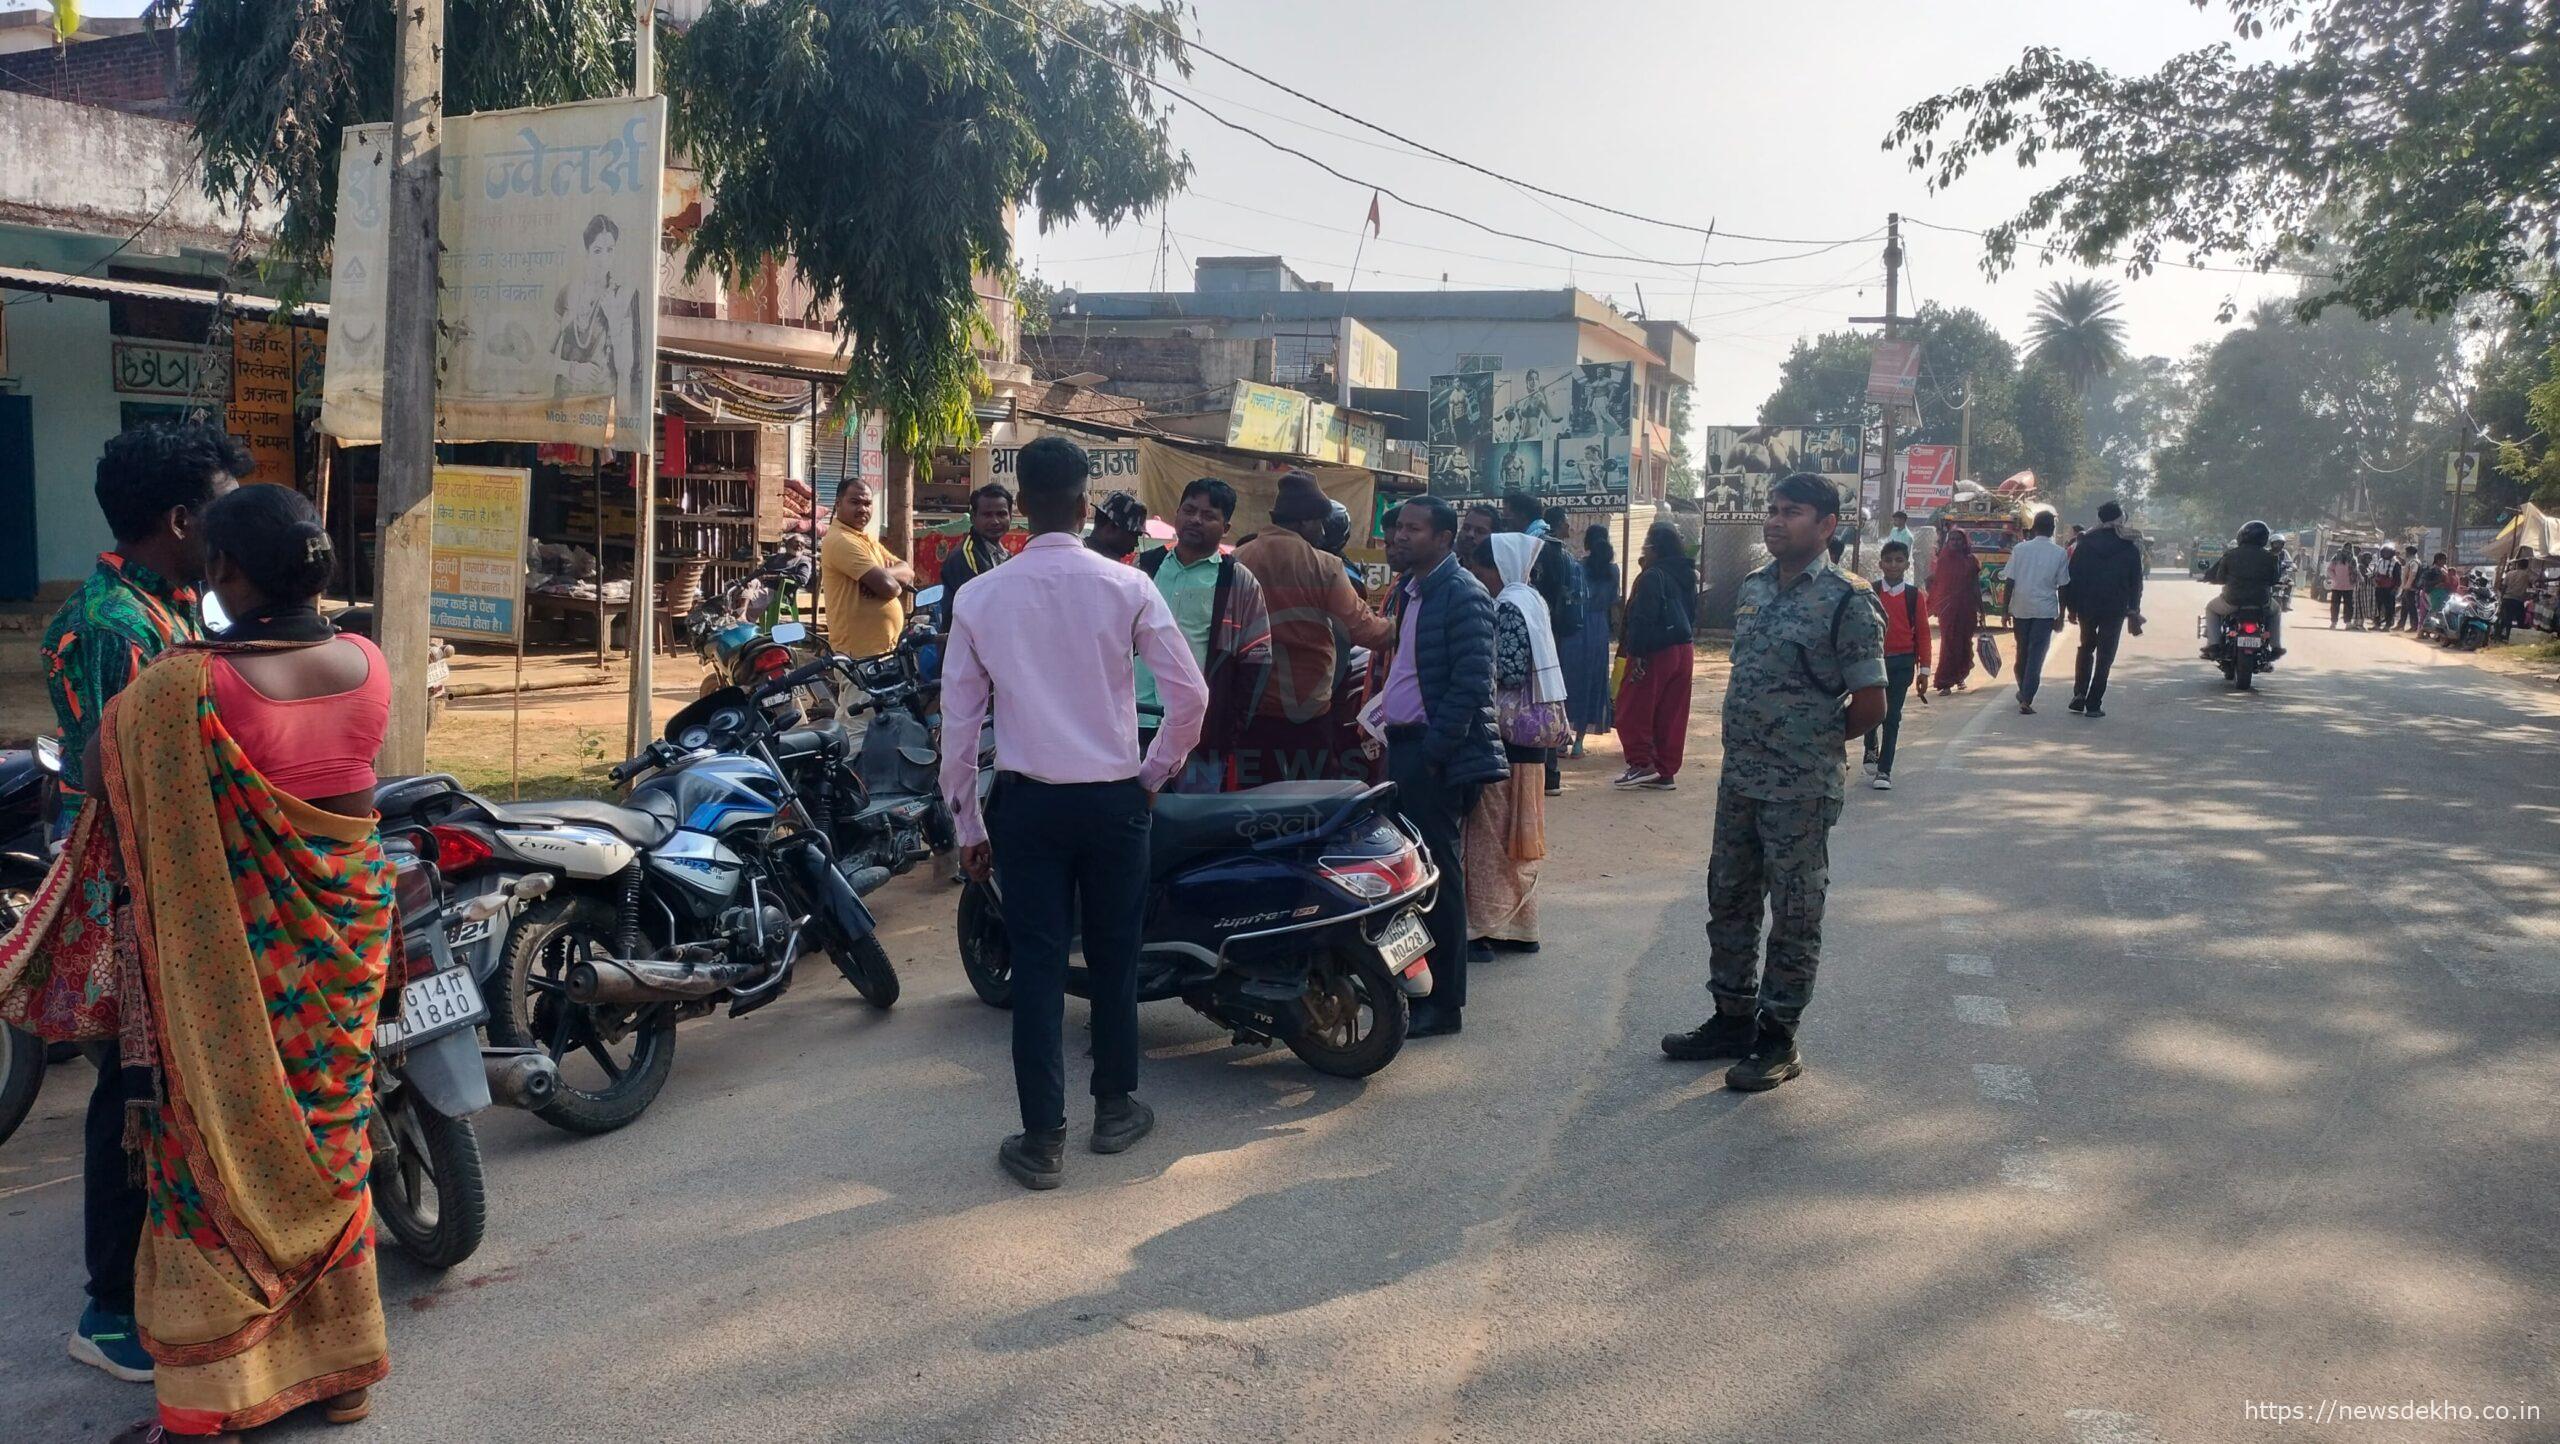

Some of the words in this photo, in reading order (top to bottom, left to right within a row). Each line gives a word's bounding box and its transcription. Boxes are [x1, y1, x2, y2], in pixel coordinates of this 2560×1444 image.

[1537, 496, 1588, 507] NISEX
[1591, 495, 1627, 505] GYM
[1732, 512, 1770, 520] FITNE
[1839, 513, 1858, 521] YM
[1213, 910, 1291, 928] Jupiter
[1253, 1012, 1273, 1024] TVS
